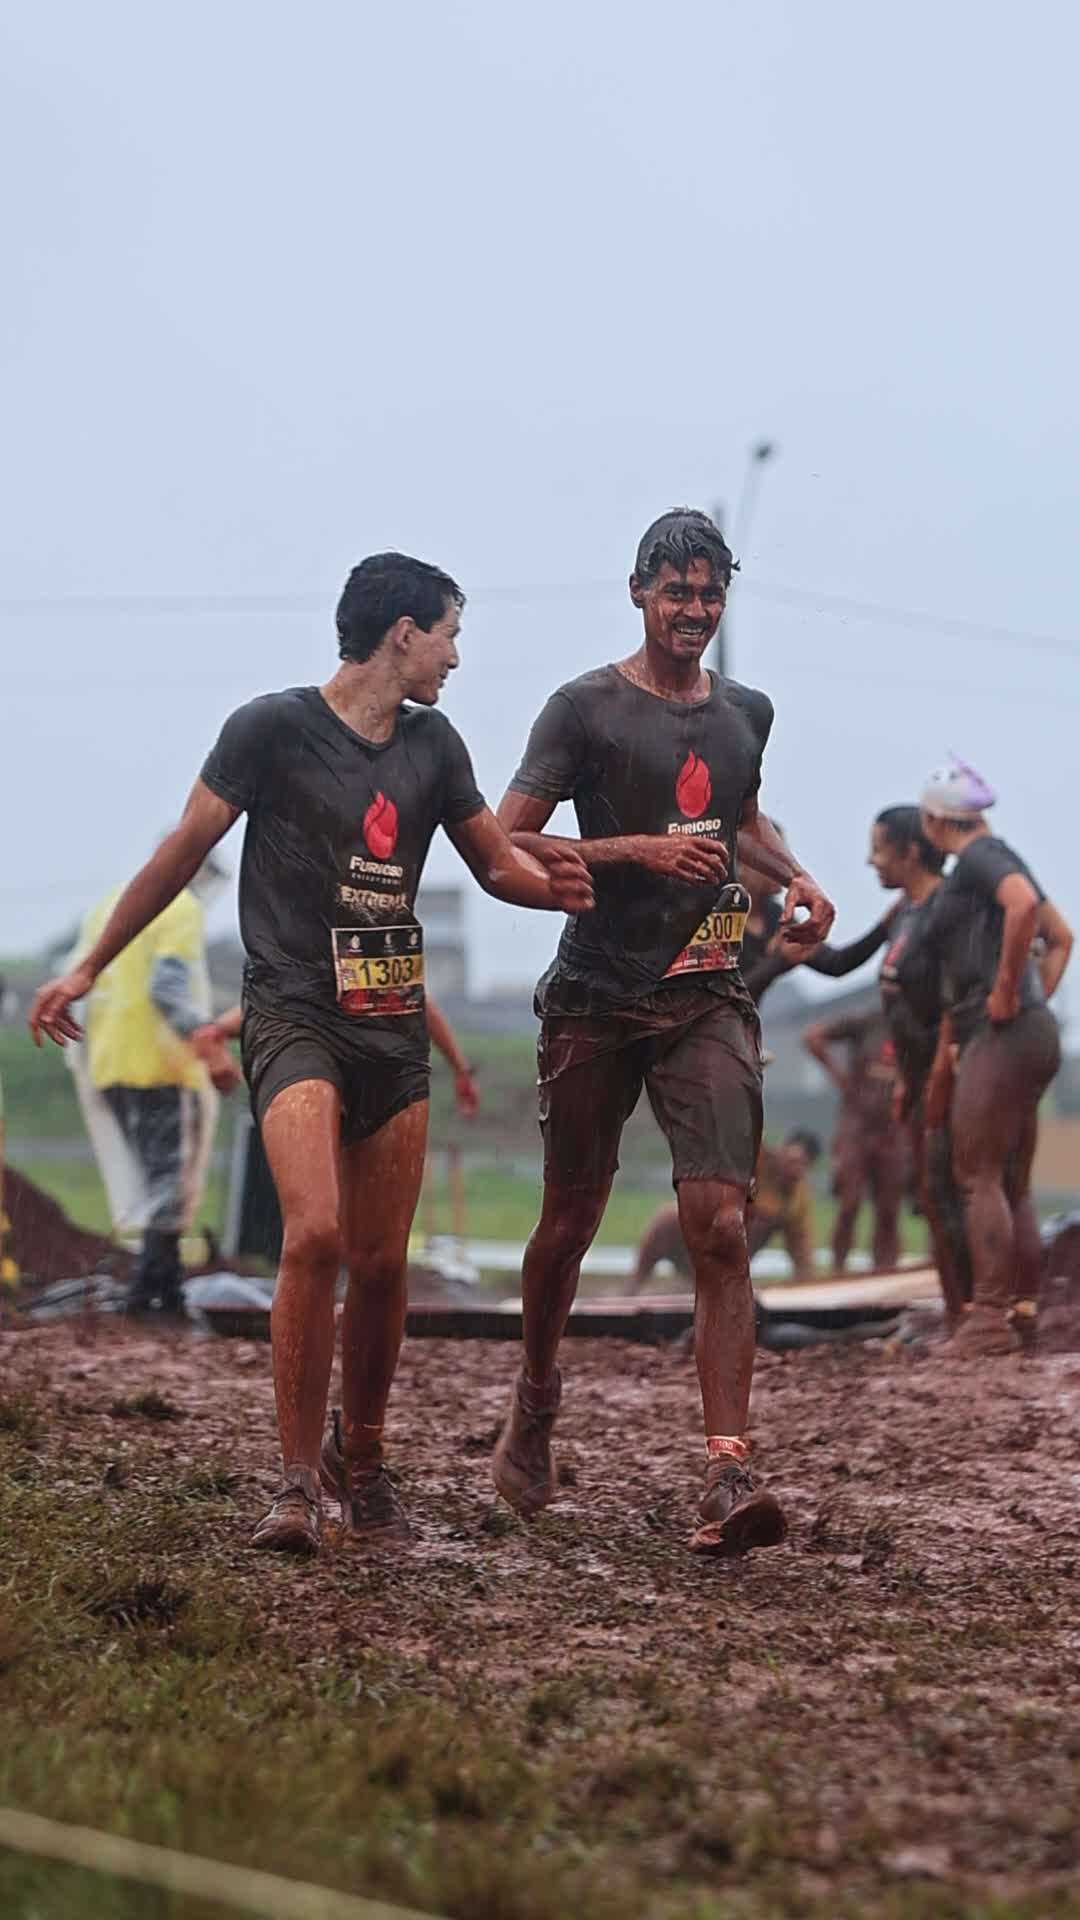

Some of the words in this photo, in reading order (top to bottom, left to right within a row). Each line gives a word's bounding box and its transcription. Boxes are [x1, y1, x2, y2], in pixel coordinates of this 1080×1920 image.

[668, 818, 721, 835] FURIOSO
[349, 856, 404, 878] FURIOSO
[696, 914, 733, 942] 300
[359, 957, 414, 986] 1303
